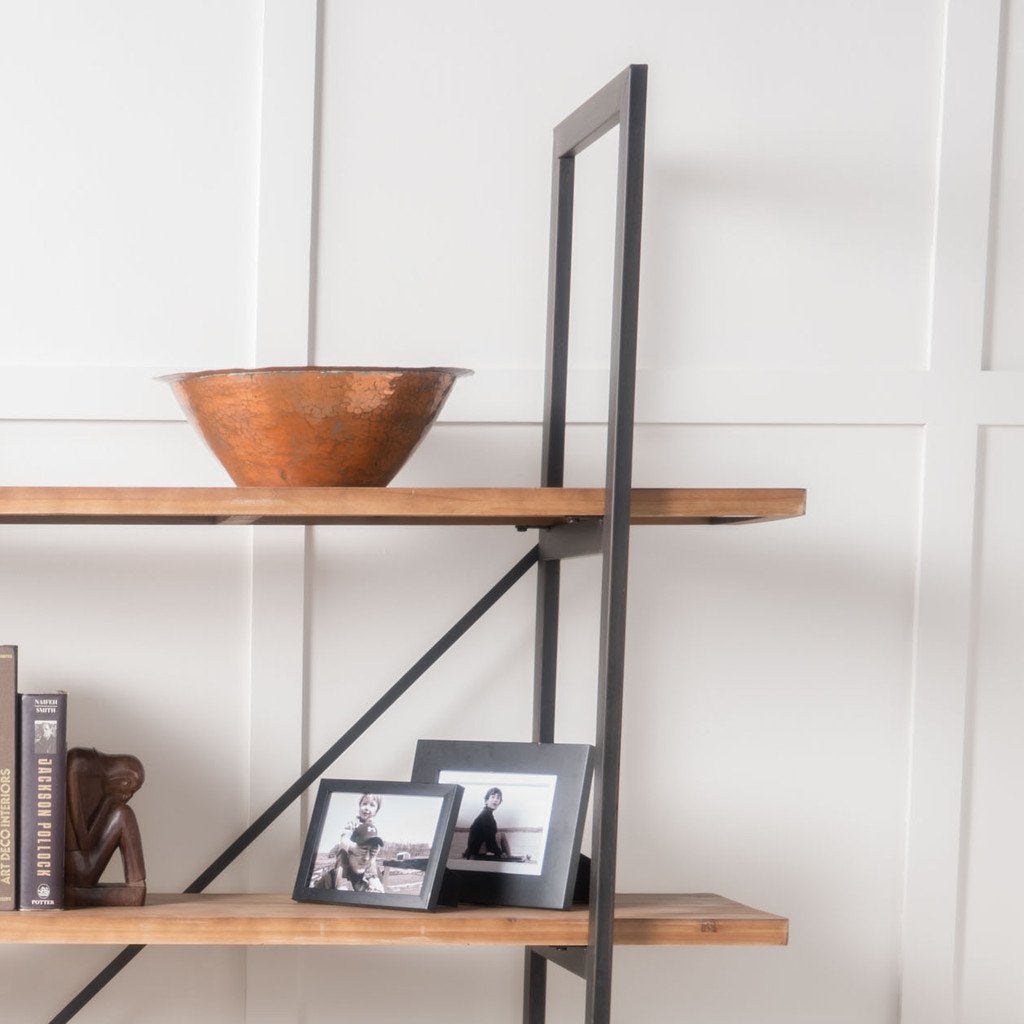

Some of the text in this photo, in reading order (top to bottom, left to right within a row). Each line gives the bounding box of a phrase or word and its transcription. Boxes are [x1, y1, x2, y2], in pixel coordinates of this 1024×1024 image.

[0, 768, 11, 828] INTERIORS
[36, 758, 53, 877] JACKSON POLLOCK
[0, 829, 11, 861] DECO
[0, 863, 11, 884] ART
